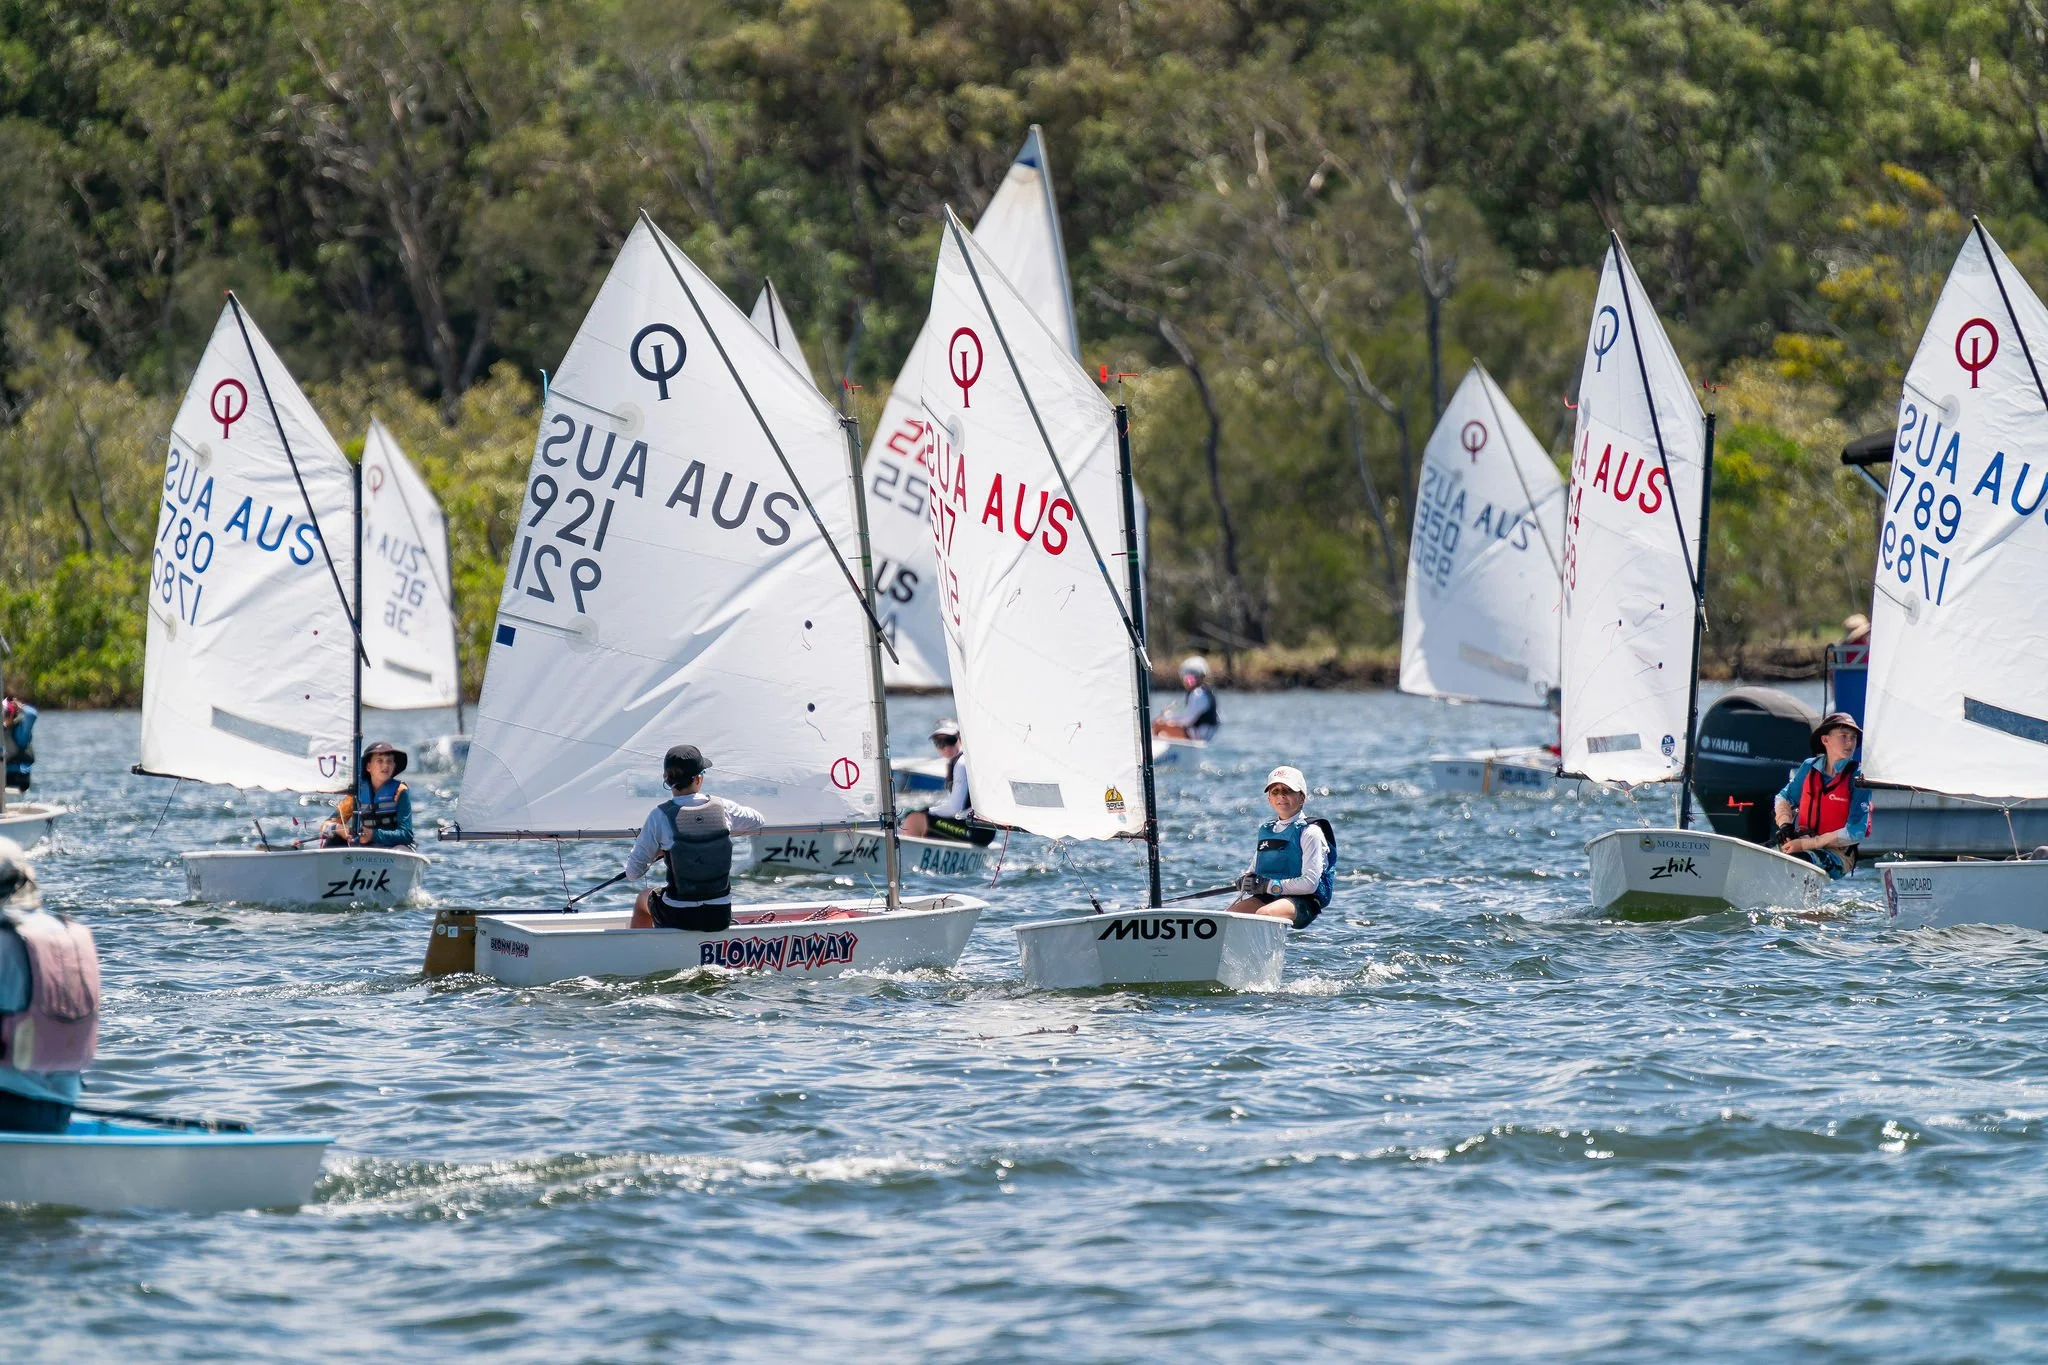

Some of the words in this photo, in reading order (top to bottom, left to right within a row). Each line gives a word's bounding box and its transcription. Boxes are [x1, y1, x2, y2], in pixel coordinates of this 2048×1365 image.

[527, 473, 616, 552] 921
[664, 459, 800, 547] AUS
[982, 472, 1074, 556] AUS
[1593, 443, 1669, 514] AUS
[1972, 451, 2048, 526] AU
[224, 495, 320, 566] AUS
[1472, 502, 1537, 551] AUS
[1711, 737, 1749, 754] YAMAHA
[1657, 840, 1710, 850] MORETON
[699, 935, 788, 972] BLOWN
[786, 931, 859, 971] AWAY
[1097, 918, 1218, 940] MUSTO
